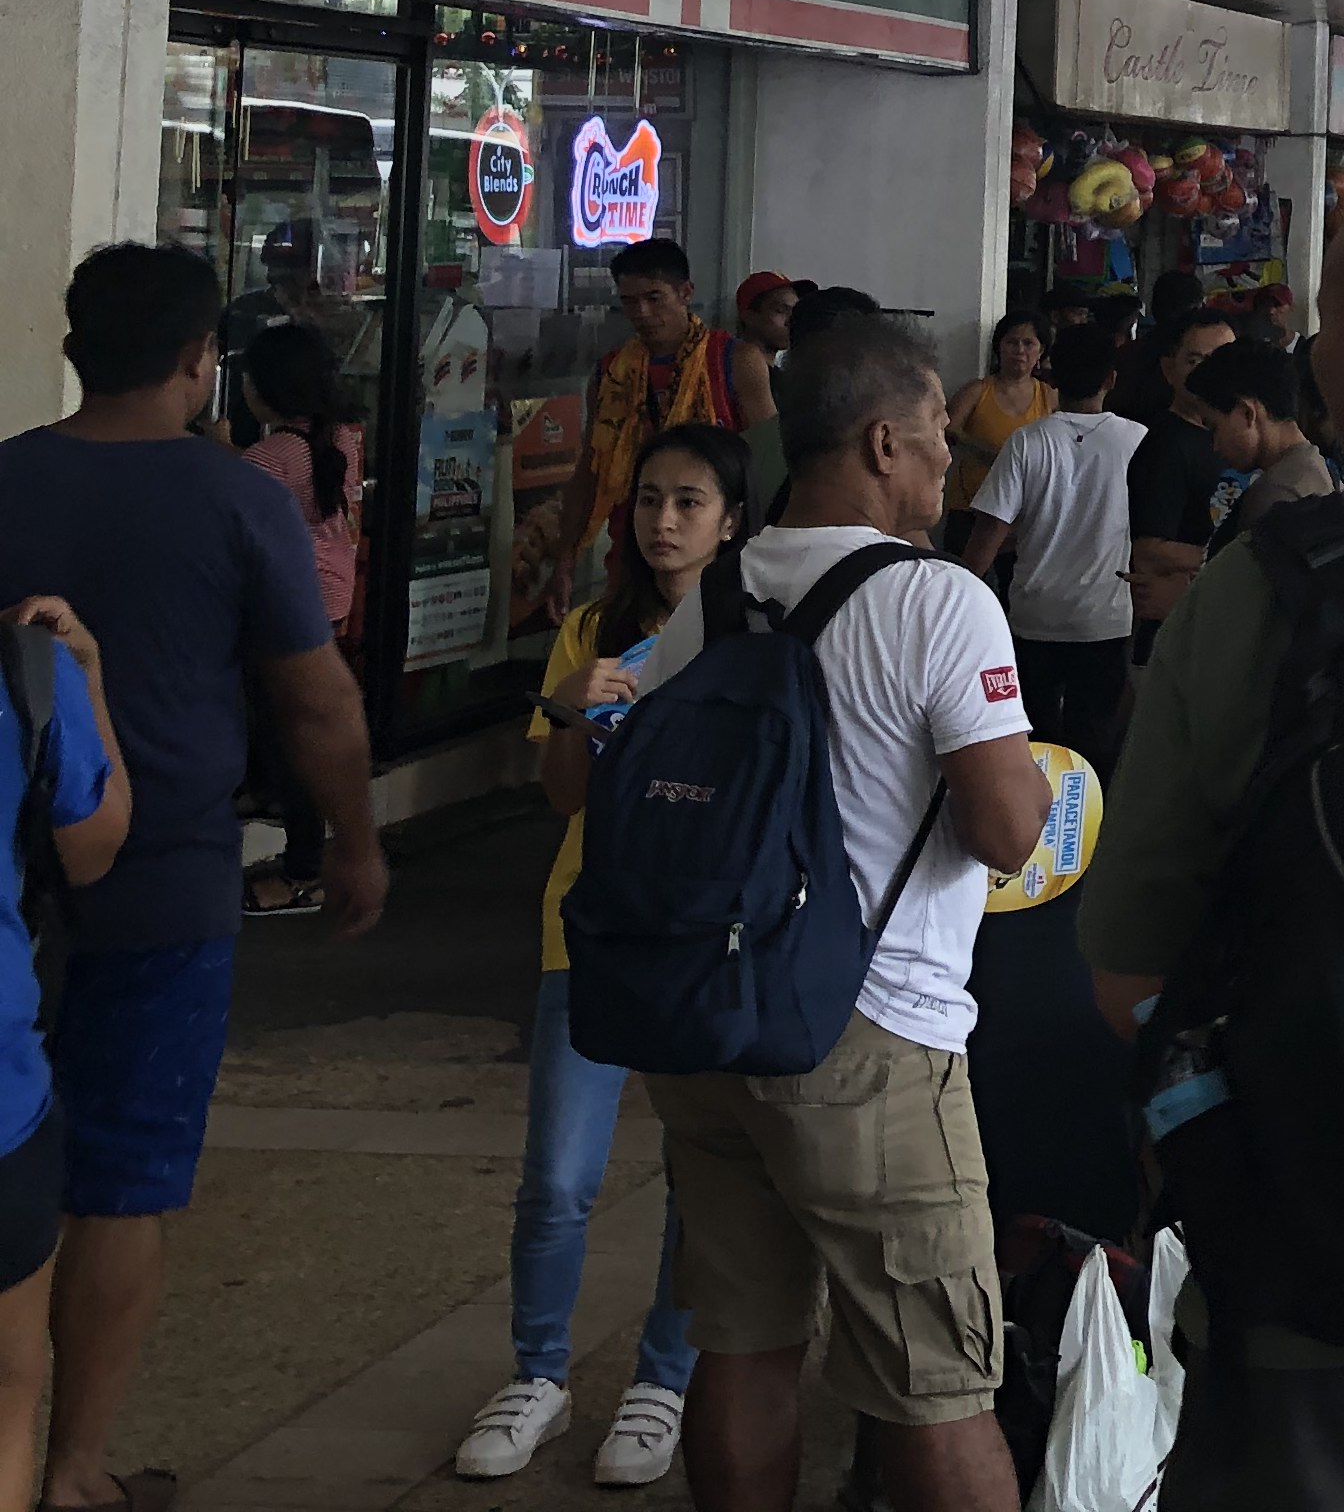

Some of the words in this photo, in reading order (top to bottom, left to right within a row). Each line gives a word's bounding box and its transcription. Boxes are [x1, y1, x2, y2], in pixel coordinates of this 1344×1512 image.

[1103, 17, 1185, 85] Castle
[484, 175, 519, 194] Blends
[490, 155, 513, 176] City
[580, 142, 641, 233] CRUNCH
[607, 201, 648, 230] TIME
[1060, 775, 1082, 870] PARACETAMOL
